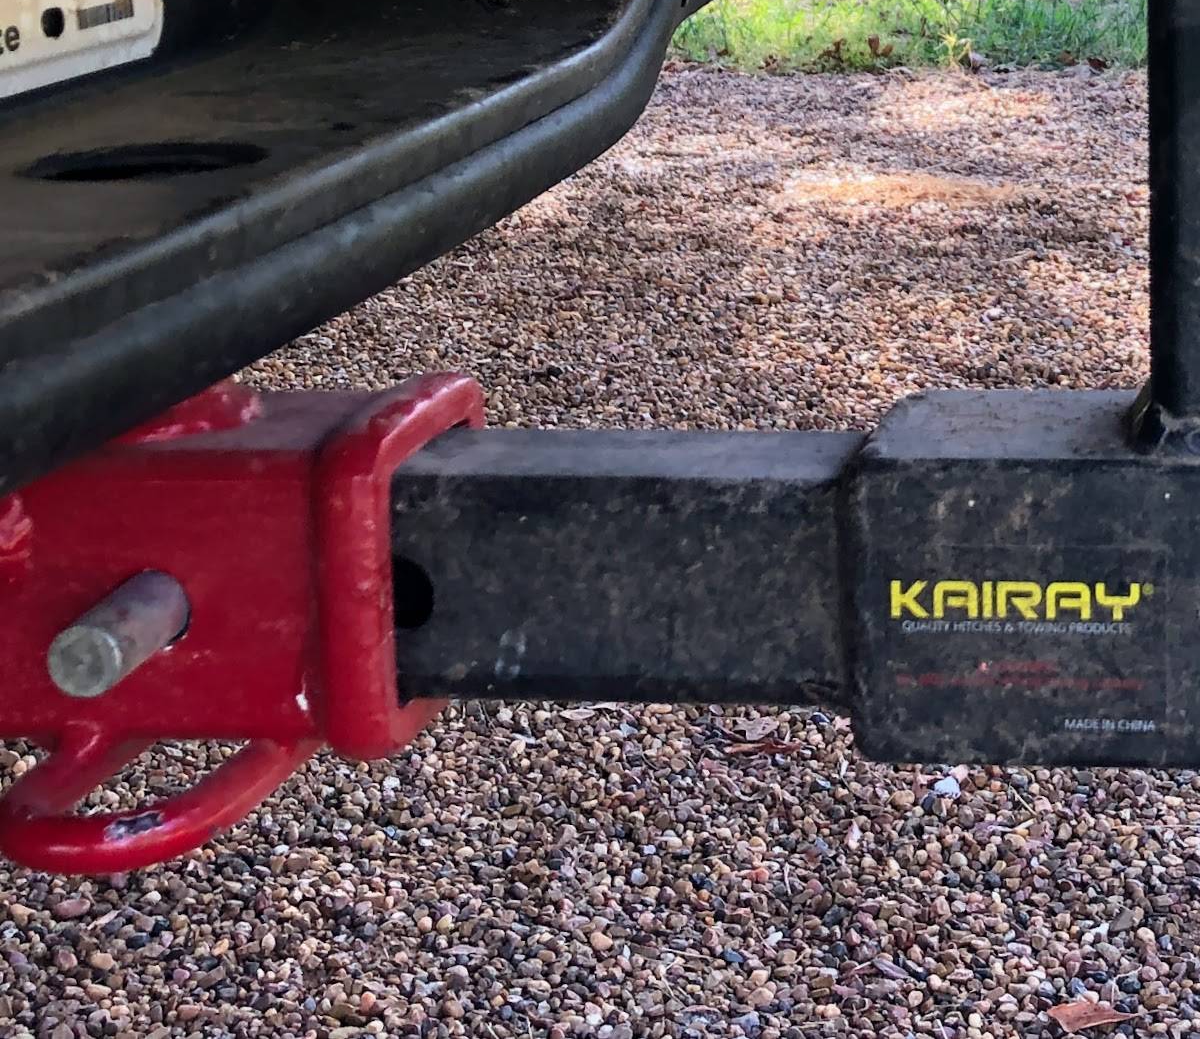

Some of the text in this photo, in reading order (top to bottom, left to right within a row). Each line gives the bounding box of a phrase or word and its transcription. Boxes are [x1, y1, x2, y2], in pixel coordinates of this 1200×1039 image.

[890, 579, 1142, 621] KAIRAY
[902, 620, 951, 634] QUALITY
[953, 620, 1002, 635] HITCHES
[1017, 621, 1066, 635] TOWING
[1068, 622, 1132, 636] PRODUCTS
[1064, 718, 1156, 732] MADE IN CHINA
